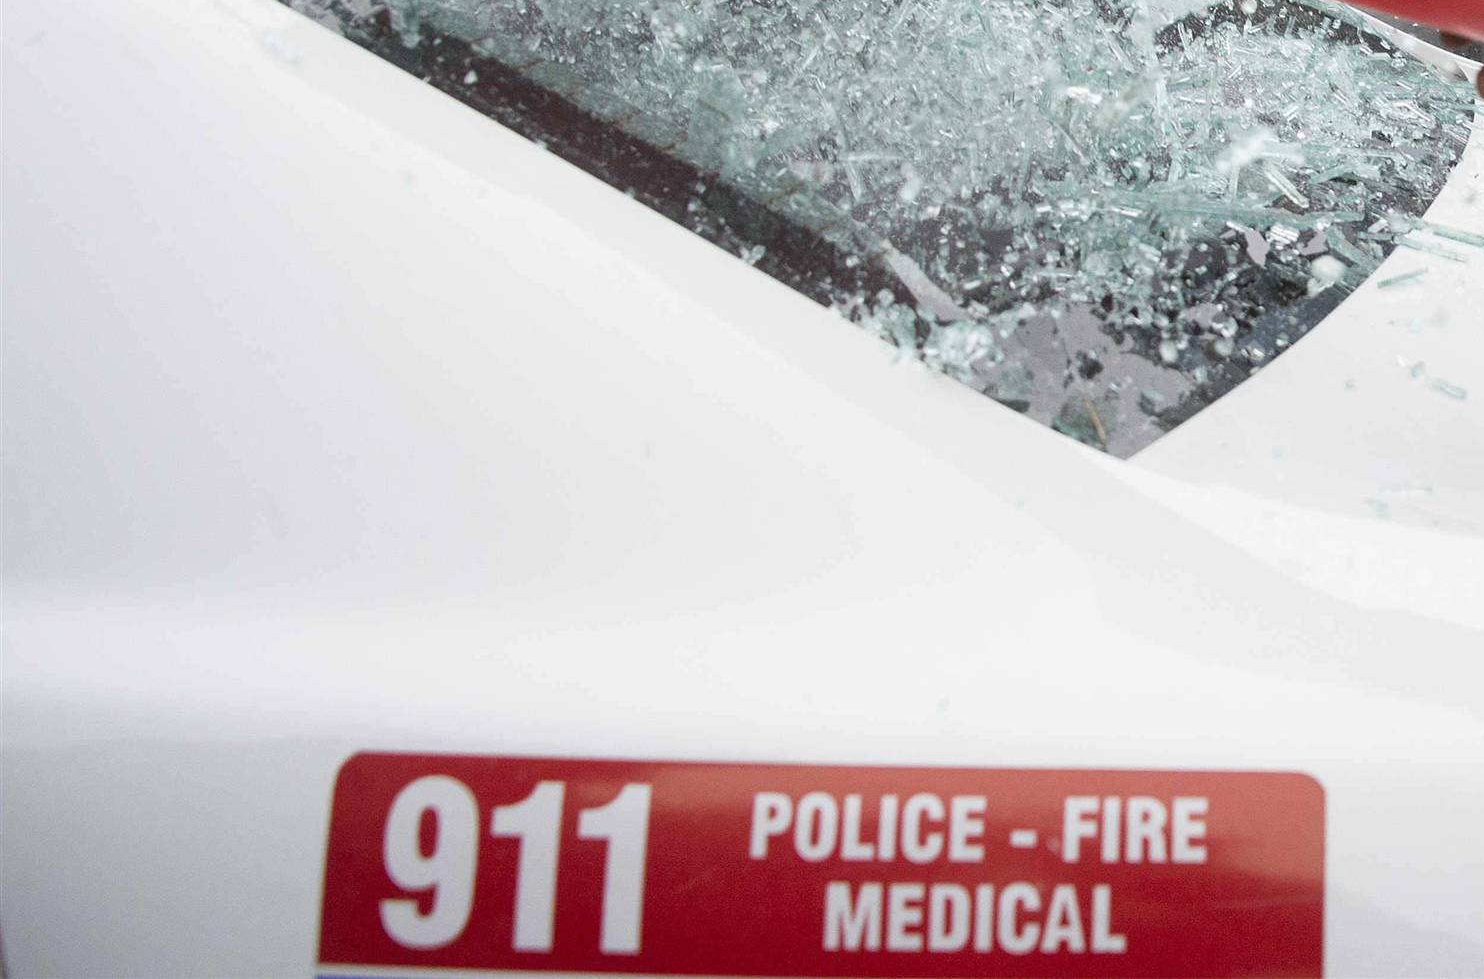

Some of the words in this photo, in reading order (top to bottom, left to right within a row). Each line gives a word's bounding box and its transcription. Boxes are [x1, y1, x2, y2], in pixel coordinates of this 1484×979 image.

[750, 790, 989, 862] POLICE
[1062, 794, 1211, 863] FIRE
[381, 775, 652, 952] 911
[824, 882, 1126, 953] MEDICAL
